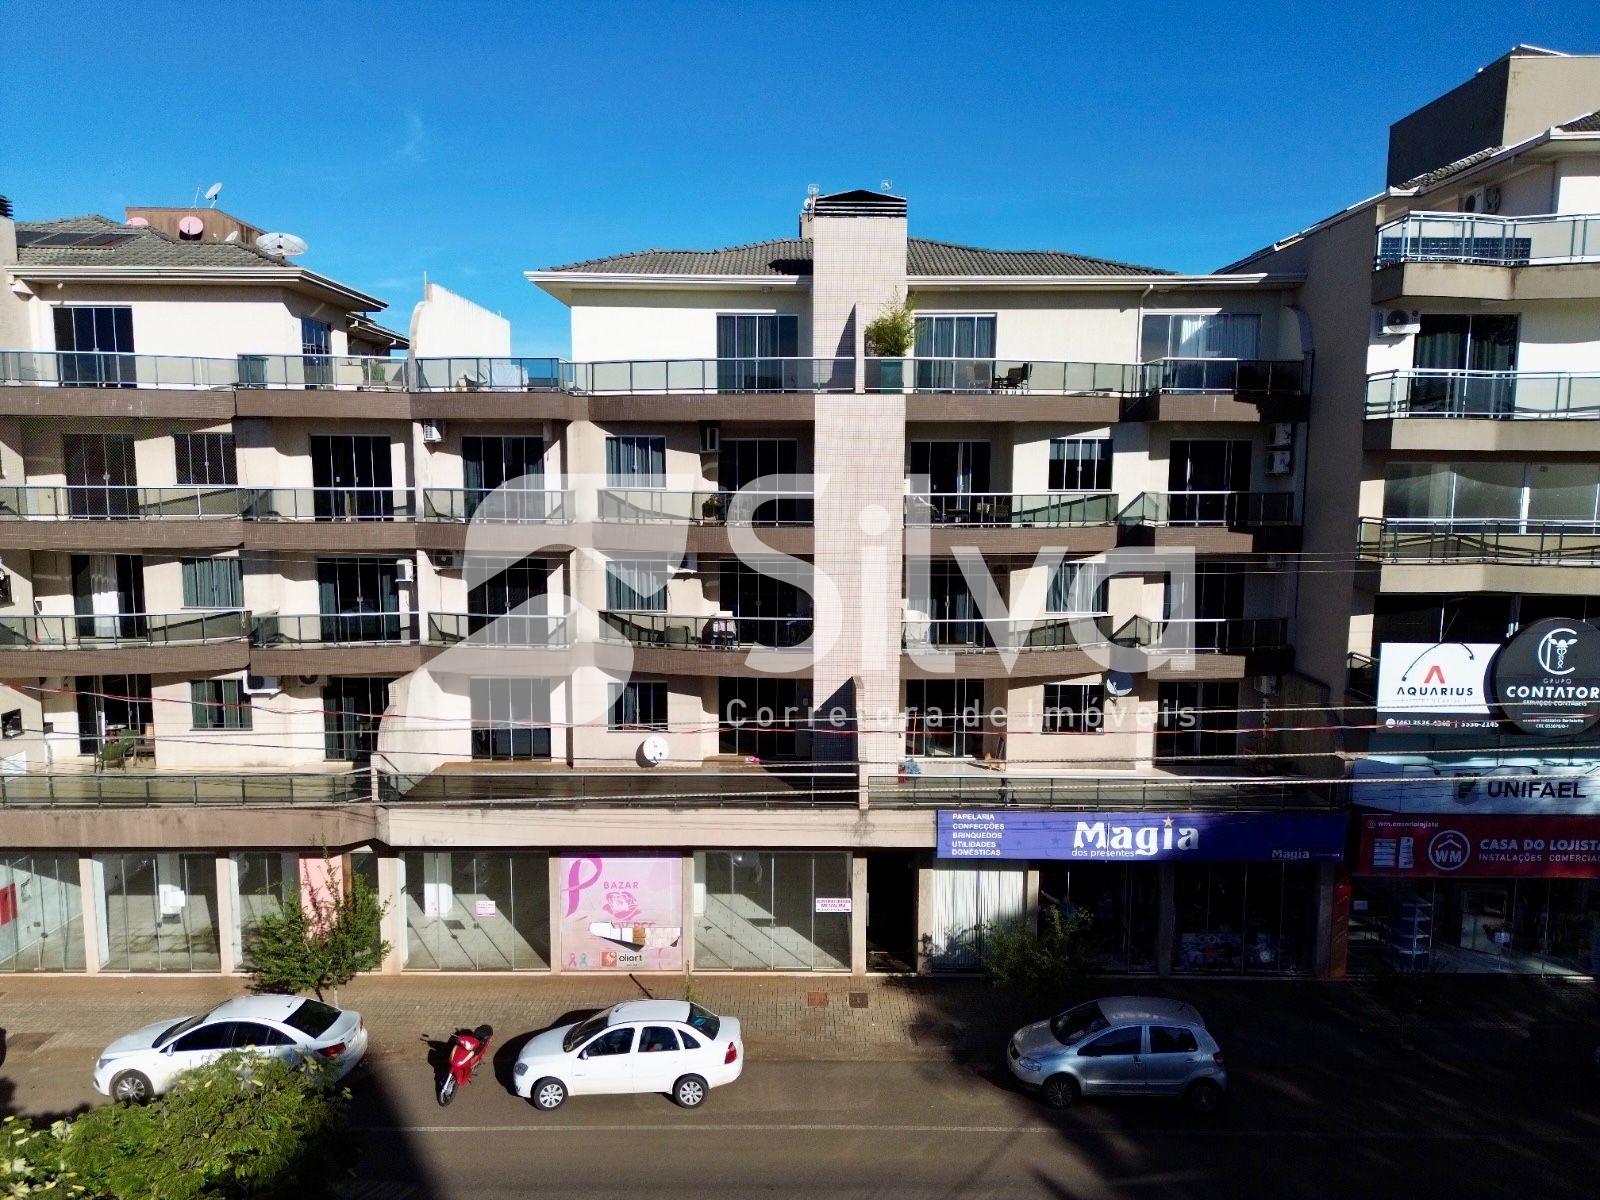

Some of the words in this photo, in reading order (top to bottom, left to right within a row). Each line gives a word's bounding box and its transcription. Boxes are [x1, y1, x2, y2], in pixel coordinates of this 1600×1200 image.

[1397, 686, 1474, 696] AQUARIUS
[1506, 685, 1600, 699] CONTATOR
[1487, 781, 1587, 799] UNIFAEL
[952, 822, 1005, 830] CONFECÇÕES
[1073, 816, 1200, 856] Magia
[1480, 839, 1518, 850] CASA
[1523, 839, 1546, 851] DO
[951, 848, 1001, 856] DOMÉSTICAS
[1071, 849, 1088, 857] dos
[1090, 849, 1135, 858] presentes
[1271, 848, 1310, 860] Magia
[1435, 850, 1462, 862] WM
[1479, 853, 1542, 864] INSTALAÇÕES
[603, 881, 640, 889] BAZAR
